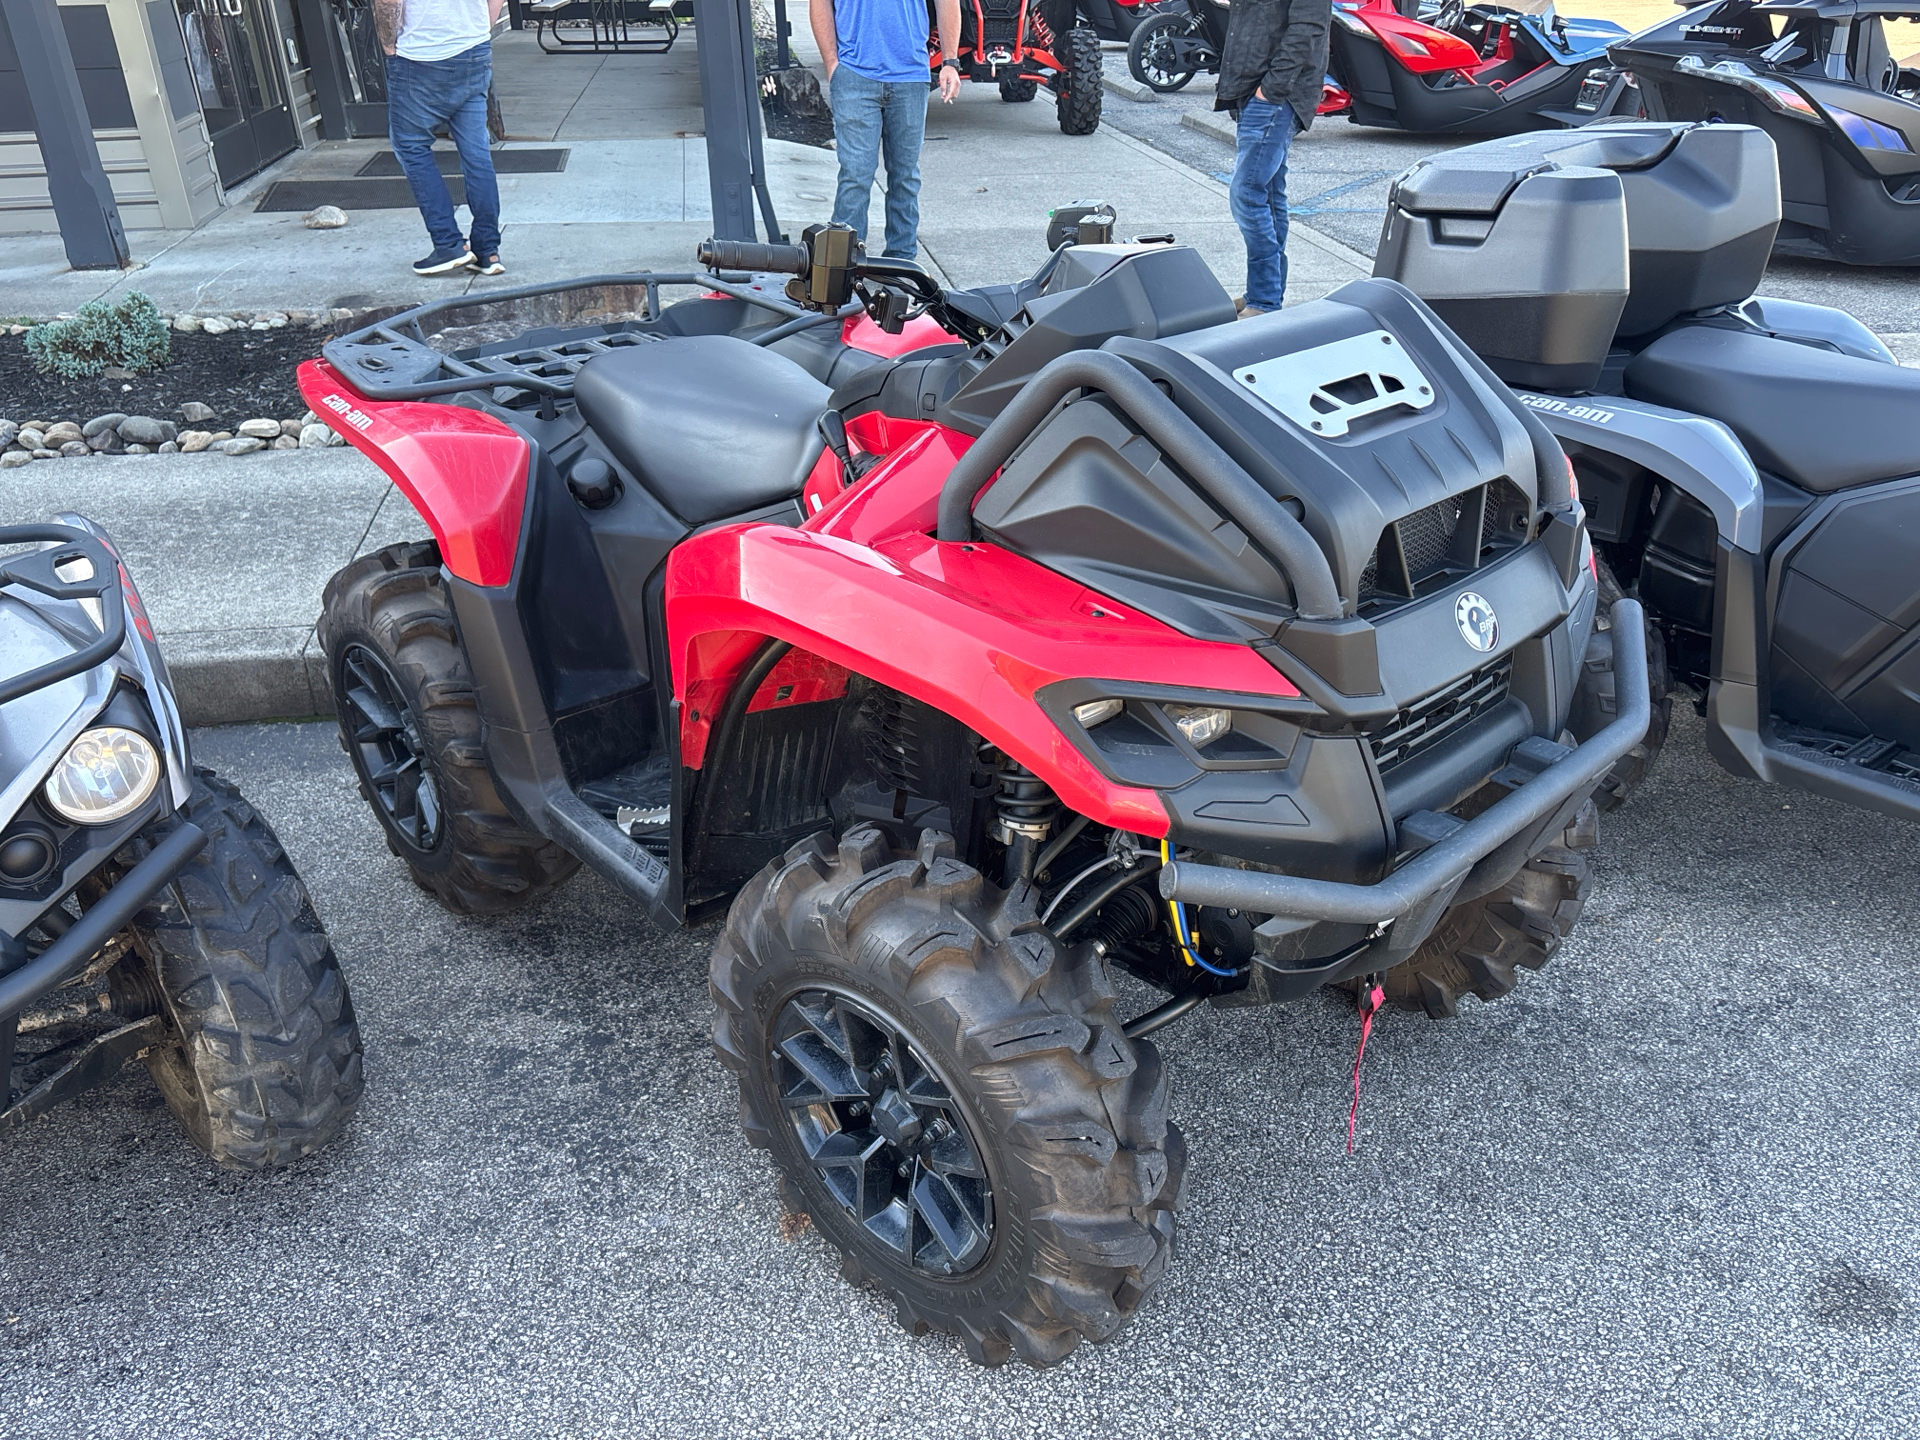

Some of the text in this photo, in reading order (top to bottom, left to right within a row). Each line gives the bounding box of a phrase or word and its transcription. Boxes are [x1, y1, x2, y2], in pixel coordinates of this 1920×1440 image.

[321, 393, 374, 431] can-am
[1518, 394, 1615, 424] can-am
[1479, 616, 1496, 634] BRP
